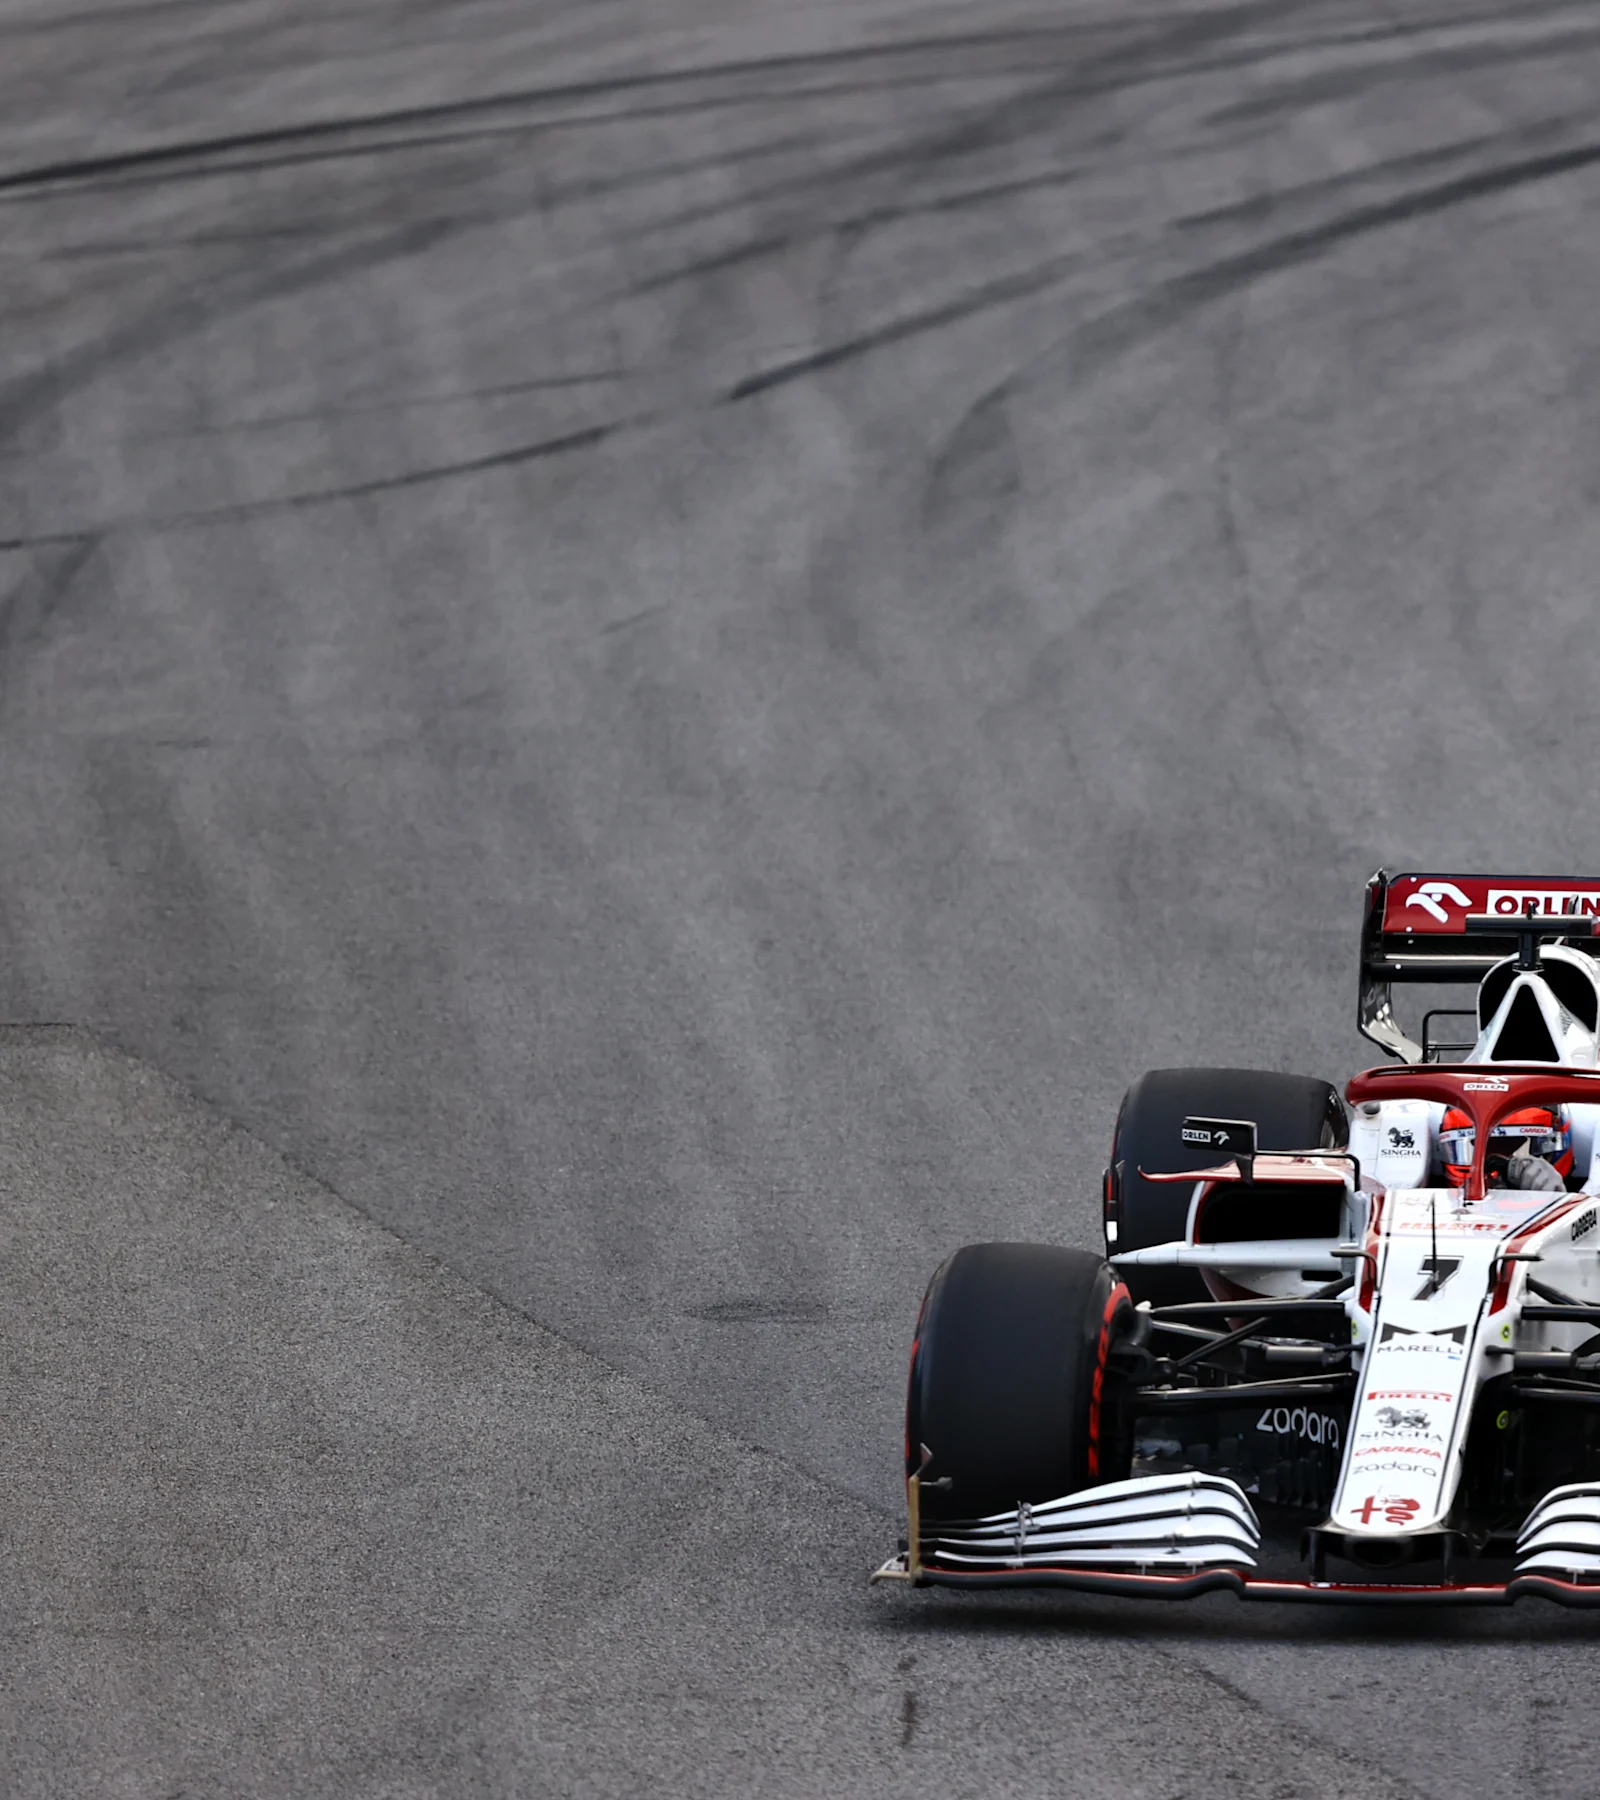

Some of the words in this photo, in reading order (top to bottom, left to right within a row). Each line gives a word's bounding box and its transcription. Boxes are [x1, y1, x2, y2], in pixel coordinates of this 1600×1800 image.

[1183, 1131, 1209, 1140] ORLEN
[1410, 1255, 1464, 1301] 7
[1377, 1345, 1463, 1355] MARELLI
[1367, 1390, 1453, 1402] PIRELLI
[1360, 1430, 1443, 1442] SINGHA
[1355, 1446, 1441, 1460] CARRERA
[1353, 1461, 1437, 1477] zadara
